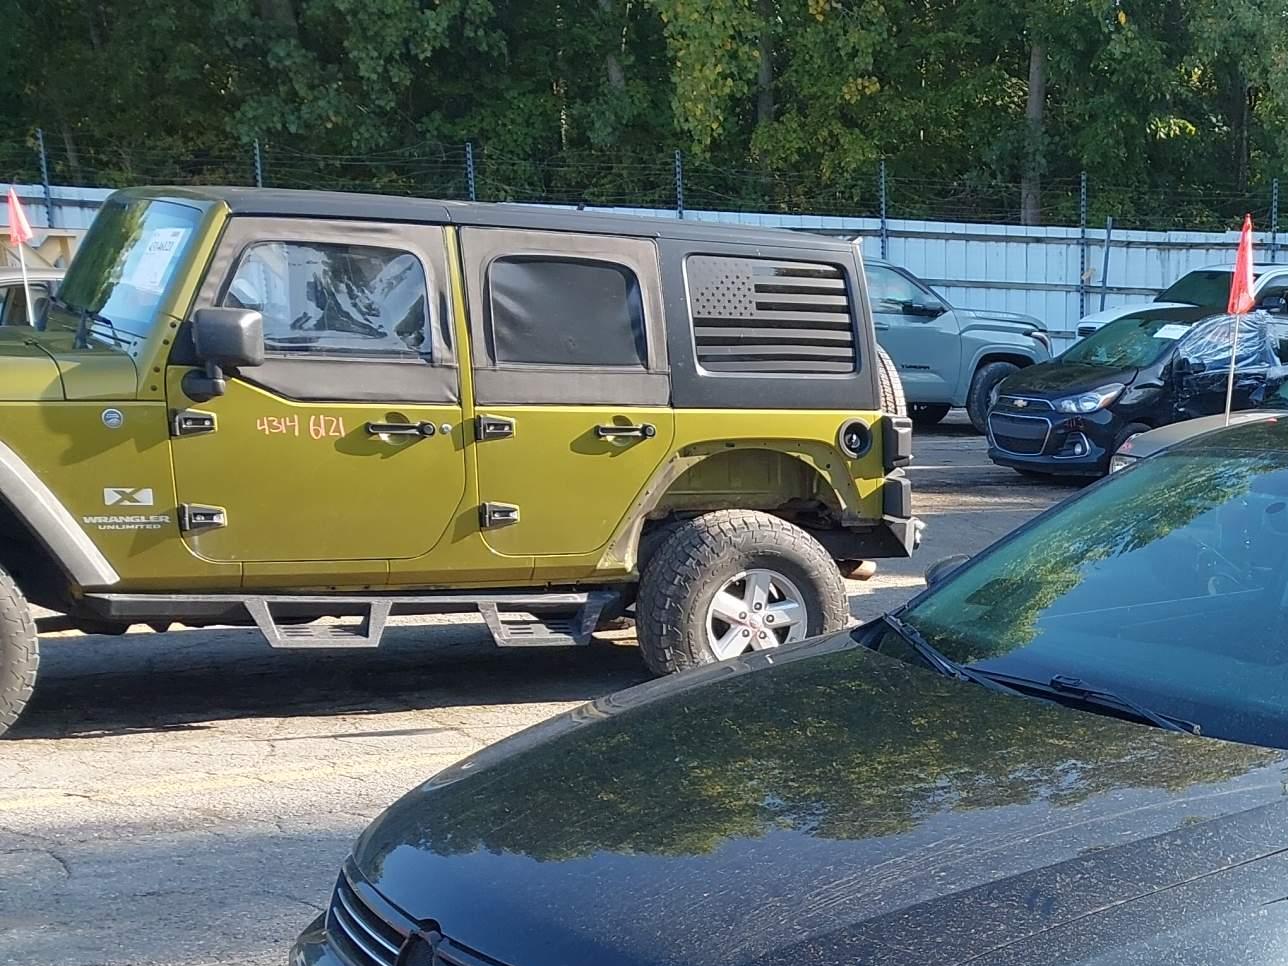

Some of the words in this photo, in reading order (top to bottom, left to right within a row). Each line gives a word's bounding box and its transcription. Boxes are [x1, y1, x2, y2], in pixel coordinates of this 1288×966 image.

[256, 414, 299, 437] 4314
[309, 414, 346, 440] 6121
[82, 515, 170, 524] WRANGLER
